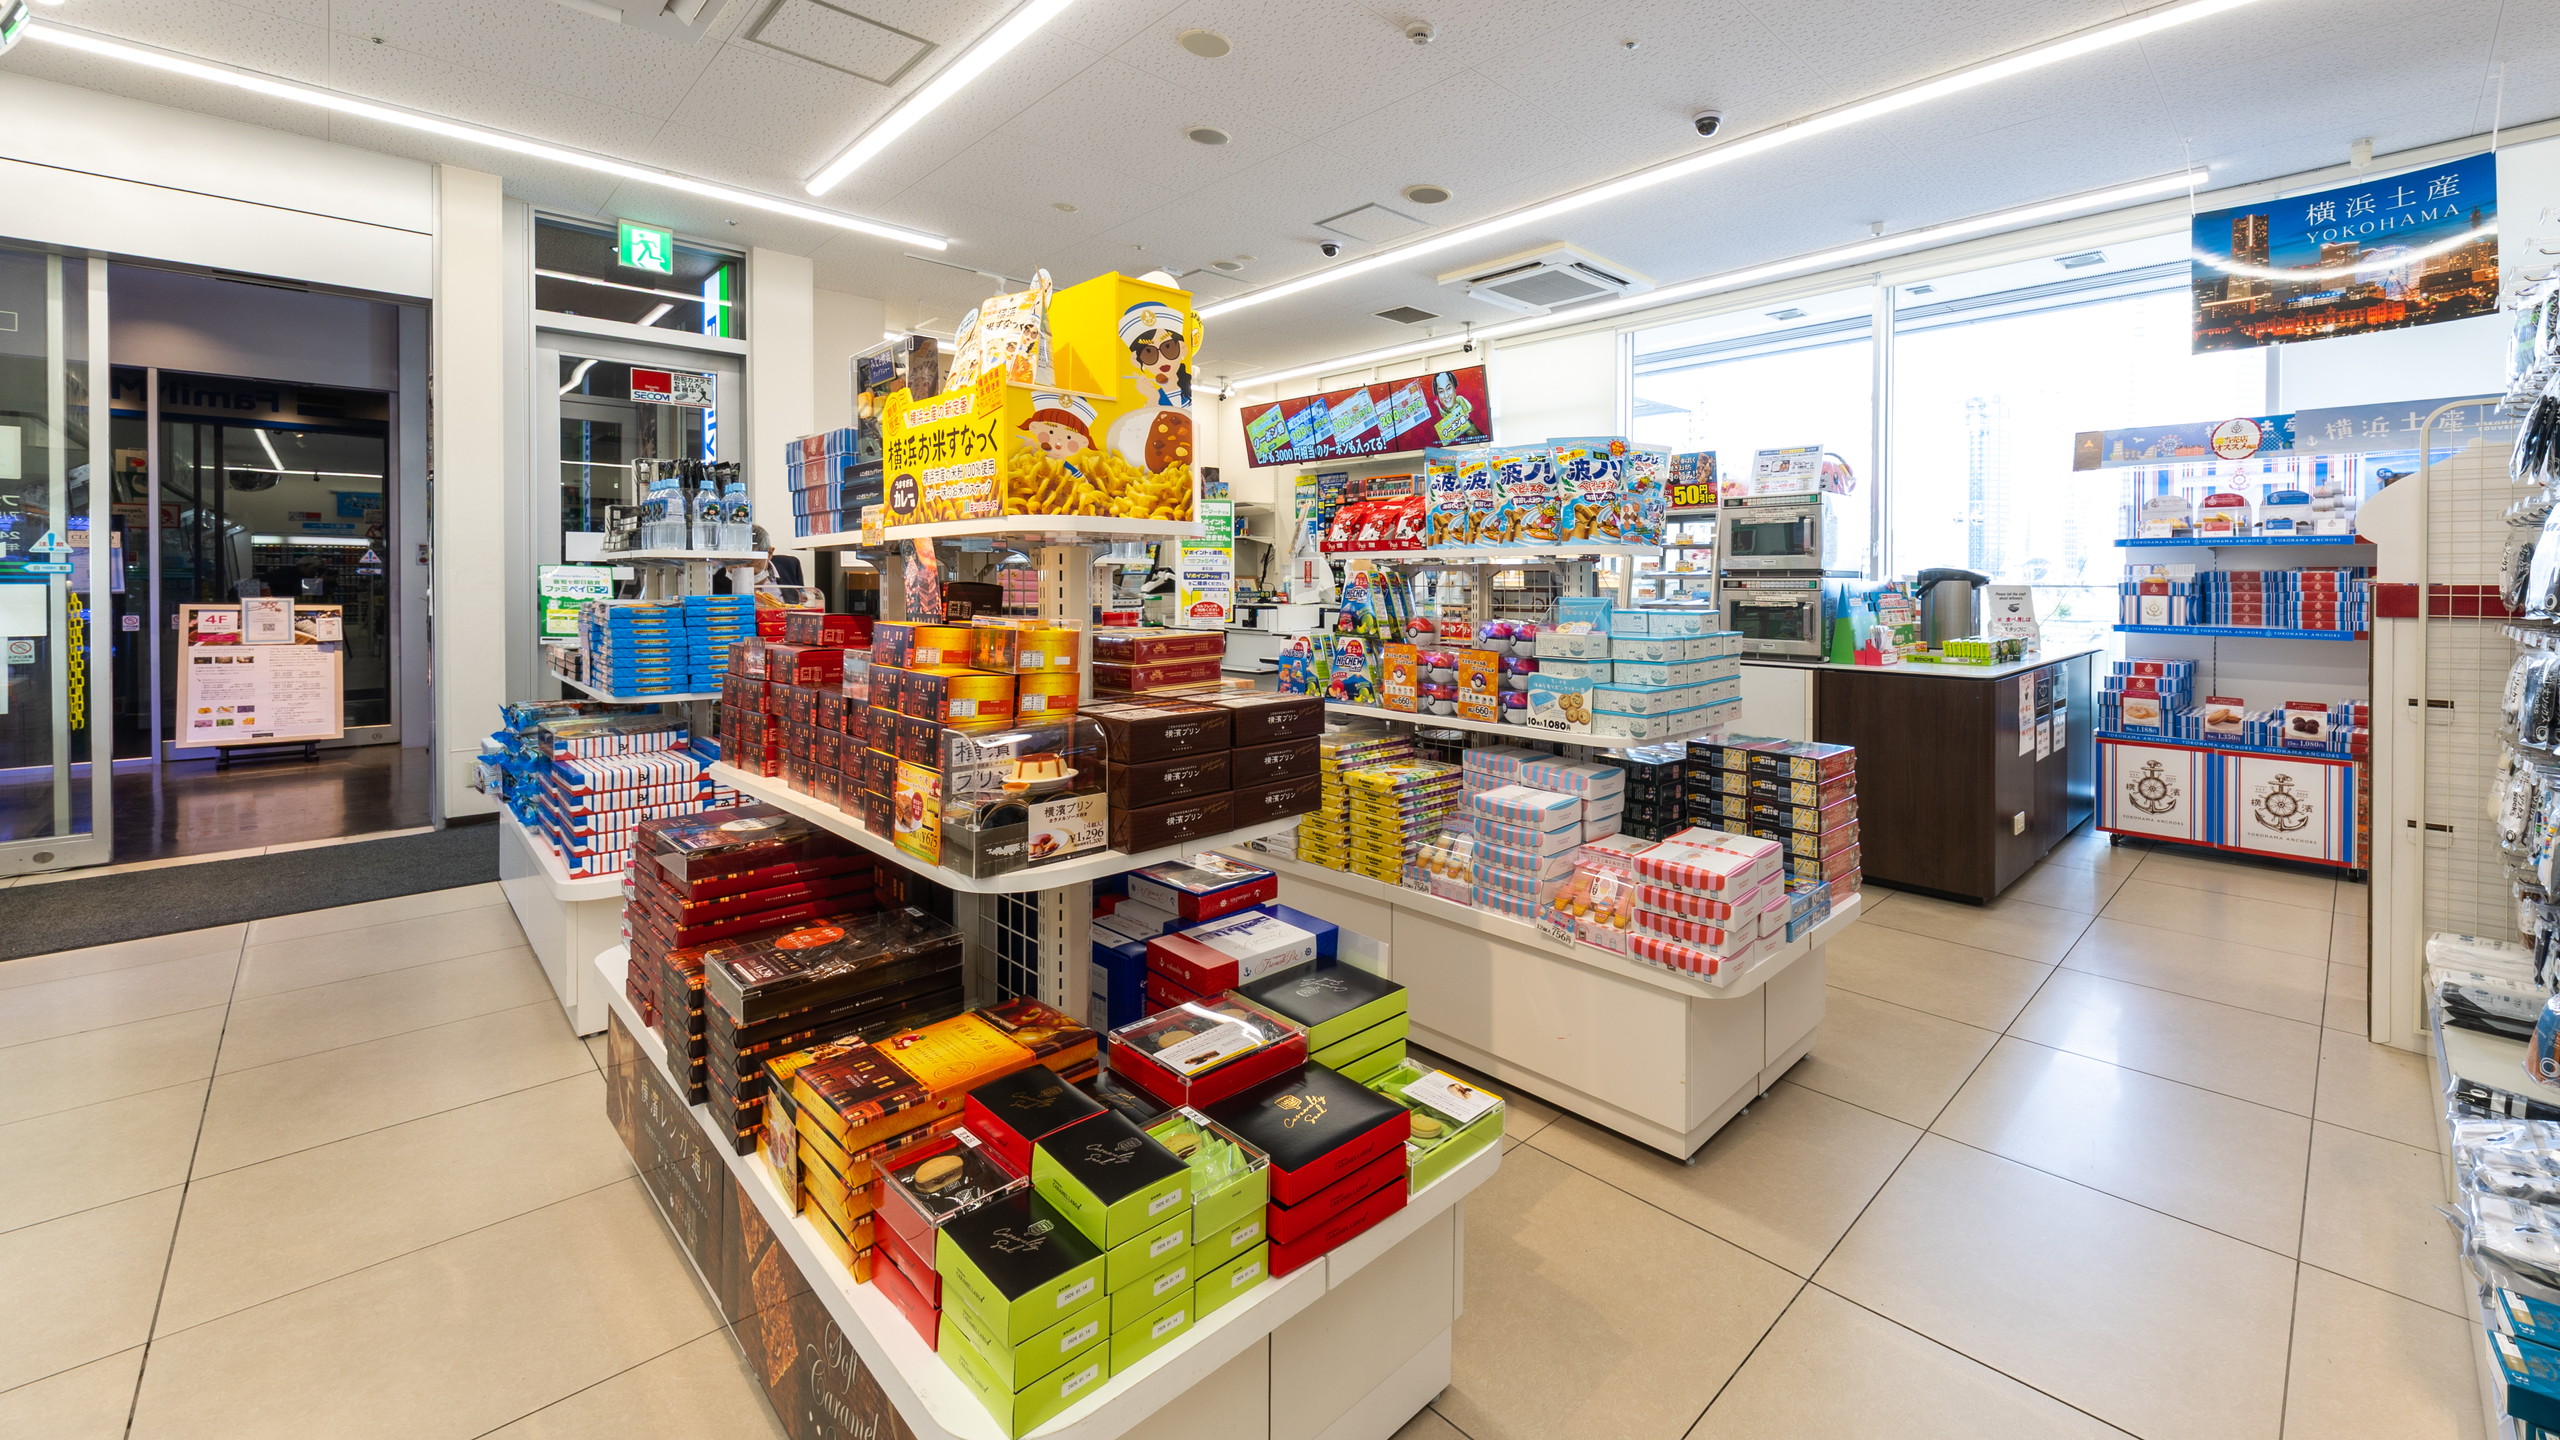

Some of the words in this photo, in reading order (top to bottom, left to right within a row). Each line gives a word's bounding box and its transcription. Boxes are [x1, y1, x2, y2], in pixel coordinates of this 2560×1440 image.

[2305, 173, 2461, 227] 横浜土産
[2306, 203, 2461, 245] YOKOHAMA
[674, 376, 711, 386] 防犯カメラで
[634, 391, 670, 402] SECOM
[909, 396, 969, 427] 横浜土産の新定番
[2325, 410, 2466, 441] 横浜土産
[1253, 420, 1286, 450] クーポン券
[888, 418, 999, 471] 横浜お米すなっく
[1501, 463, 1556, 485] 波ノリ
[1566, 459, 1623, 481] 波ノリ
[1508, 482, 1550, 496] ベビースター
[205, 615, 228, 624] 4F
[1336, 655, 1365, 667] HI-CHEW
[1268, 712, 1299, 725] 横濱プリン
[1165, 726, 1201, 739] 横濱プリン
[2107, 732, 2141, 740] YOKOHAMA
[2143, 736, 2172, 744] ANCHORS
[2182, 740, 2218, 748] YOKOHAMA
[2221, 743, 2252, 751] ANCHORS
[1264, 752, 1295, 765] 横濱プリン
[2263, 747, 2303, 756] YOKOHAMA
[2306, 751, 2340, 759] ANCHORS
[1164, 769, 1201, 783] 横濱プリン
[1265, 791, 1296, 804] 横濱プリン
[1044, 800, 1094, 819] 横濱プリン
[1049, 812, 1089, 824] カラメルソース付き
[1167, 811, 1203, 826] 横濱プリン
[2123, 814, 2154, 822] YOKOHAMA
[2157, 819, 2184, 827] ANCHORS
[1069, 827, 1104, 844] ¥1,296
[2247, 832, 2283, 840] YOKOHAMA
[2286, 836, 2317, 845] ANCHORS
